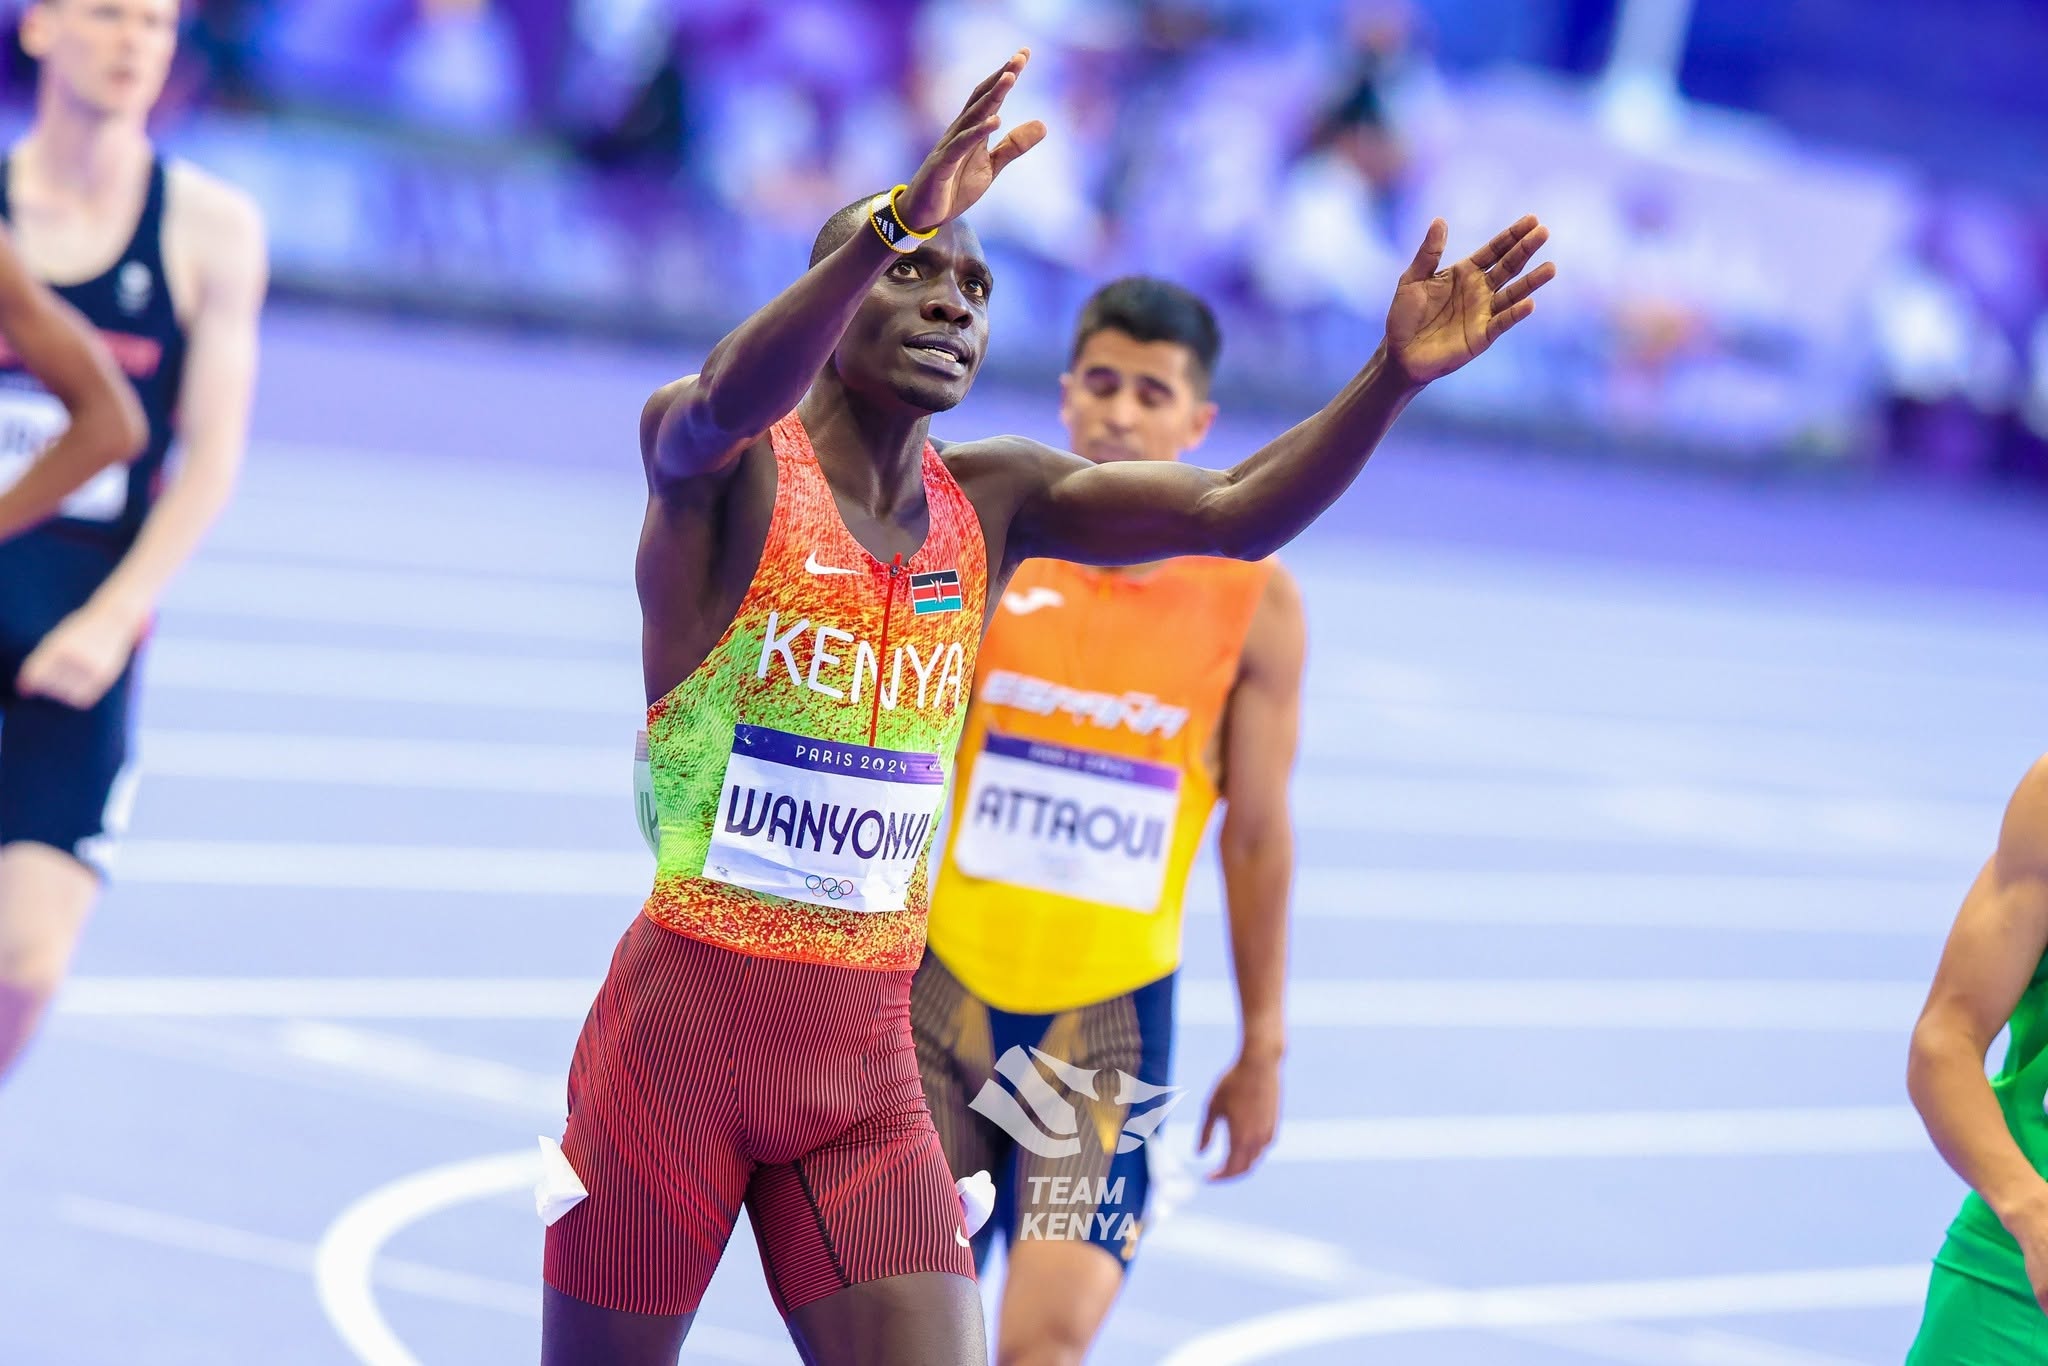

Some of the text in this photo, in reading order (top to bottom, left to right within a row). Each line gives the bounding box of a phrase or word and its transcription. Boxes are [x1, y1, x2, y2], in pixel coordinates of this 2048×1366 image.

[757, 611, 964, 710] KENYA
[795, 744, 908, 774] PARIS 2024
[724, 784, 931, 861] WANYONYI
[975, 785, 1165, 860] ATTAOUI
